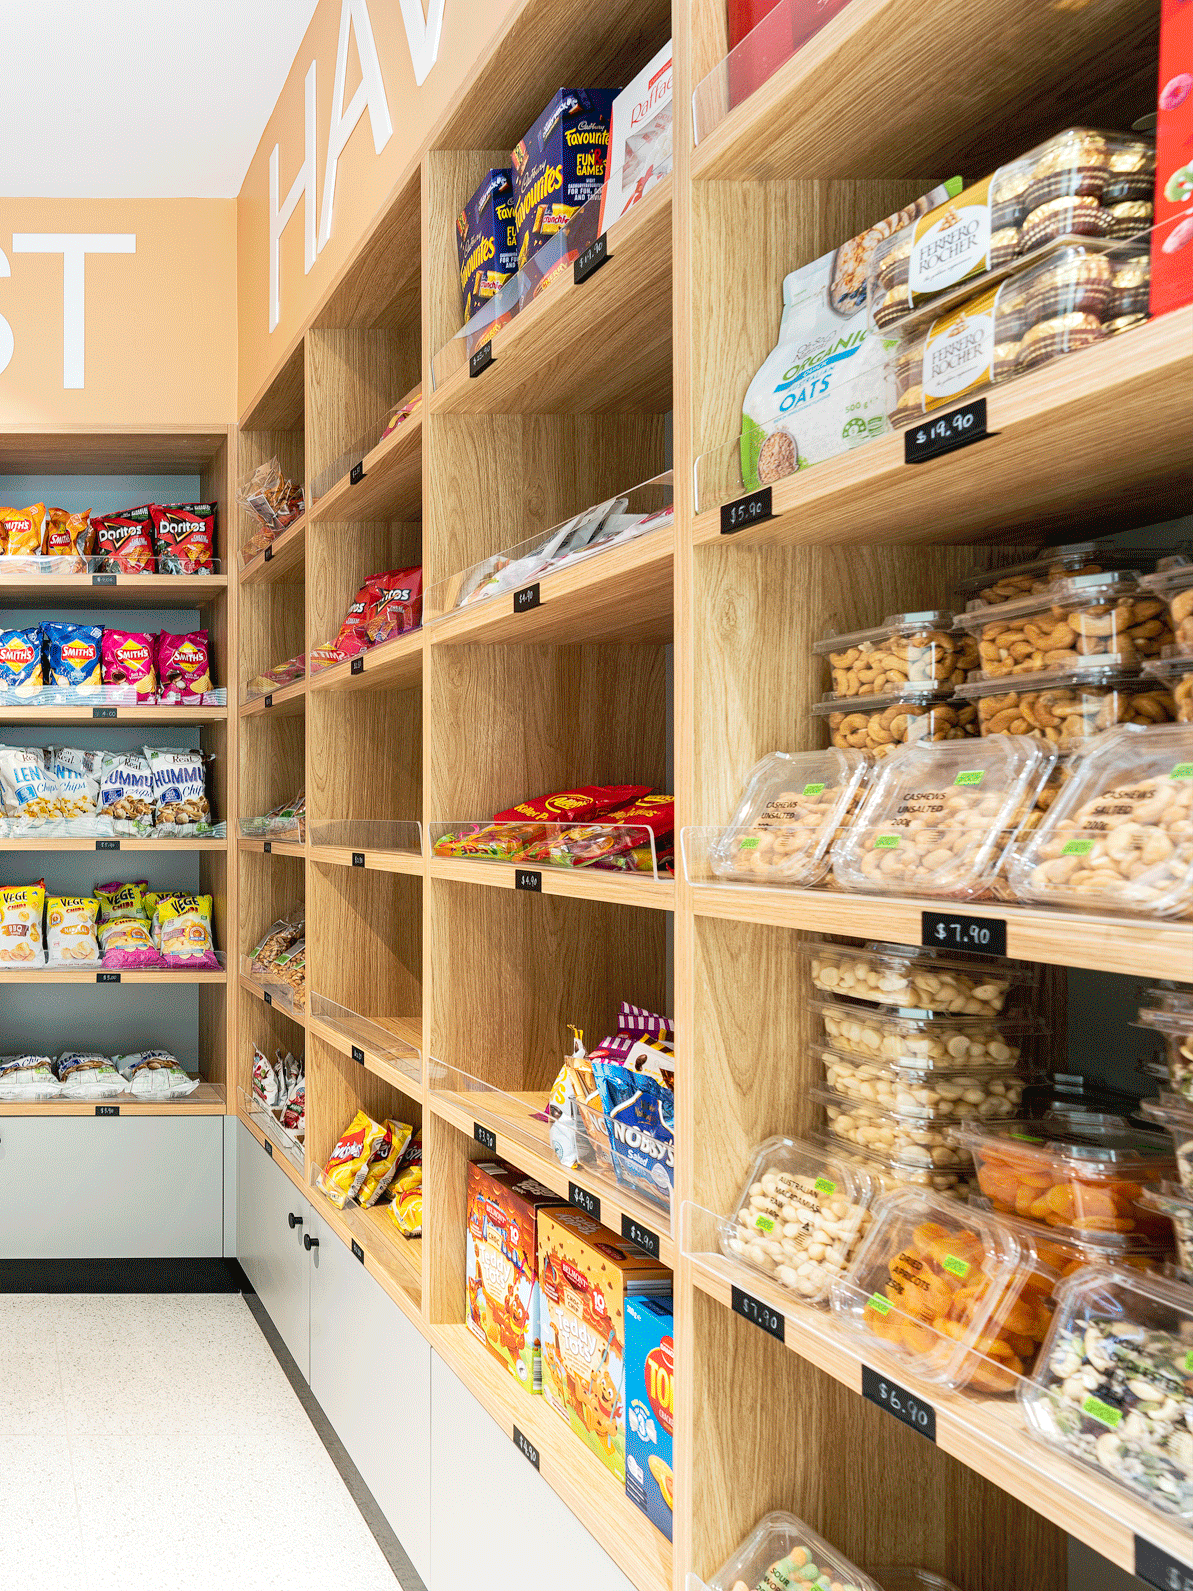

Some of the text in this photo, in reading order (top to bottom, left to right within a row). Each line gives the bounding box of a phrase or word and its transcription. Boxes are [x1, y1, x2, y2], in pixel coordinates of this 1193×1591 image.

[631, 74, 673, 128] Raffae
[565, 128, 609, 146] Favourite
[576, 153, 595, 166] FUN
[576, 165, 604, 176] GAMES
[514, 164, 563, 233] Favourites
[920, 219, 980, 261] FERRERO
[919, 234, 978, 274] ROCHER
[932, 328, 984, 365] FERRERO
[932, 343, 983, 378] ROCHER
[779, 373, 832, 412] OATS
[916, 412, 974, 444] $19.90
[730, 501, 762, 523] $5.90
[4, 520, 30, 531] MITH'S
[99, 525, 142, 540] Doritos
[159, 521, 206, 534] Doritos
[0, 650, 33, 661] SMITH'S
[62, 647, 96, 658] SMITH'S
[117, 650, 149, 660] SMITH'S
[174, 651, 205, 662] SMITH'S
[124, 758, 143, 770] Real
[172, 753, 195, 763] Real
[110, 770, 153, 787] UMMU
[903, 792, 946, 801] CASHEWS
[1102, 789, 1157, 799] CASHEWS
[897, 805, 943, 813] UNSALTED
[1092, 805, 1133, 815] SALTED
[891, 818, 911, 827] 200g
[3, 891, 28, 903] VEGE
[60, 898, 85, 907] VEGE
[107, 890, 135, 905] VEGE
[112, 901, 134, 911] CHIPS
[172, 896, 199, 914] VEGE
[7, 903, 27, 911] CHIPS
[934, 921, 990, 945] $7.90
[478, 1128, 494, 1148] $3.90
[779, 1176, 819, 1198] AUSTRALIAN
[573, 1188, 594, 1210] $4.90
[770, 1197, 784, 1209] RAW
[775, 1186, 822, 1214] MACADAMIAS
[486, 1204, 507, 1224] BELMONT
[509, 1225, 520, 1242] 10
[630, 1225, 654, 1250] $2.90
[479, 1244, 511, 1280] Teddy
[899, 1253, 923, 1271] DRIED
[485, 1264, 506, 1289] Tots
[562, 1263, 588, 1289] BELMONT
[893, 1266, 930, 1291] APRICOTS
[593, 1291, 606, 1310] 10
[742, 1297, 778, 1331] $7.90
[555, 1307, 596, 1356] Teddy
[563, 1331, 591, 1363] Tots
[878, 1383, 929, 1426] $6.90
[519, 1436, 538, 1464] $4.90
[770, 1567, 790, 1587] SOUR
